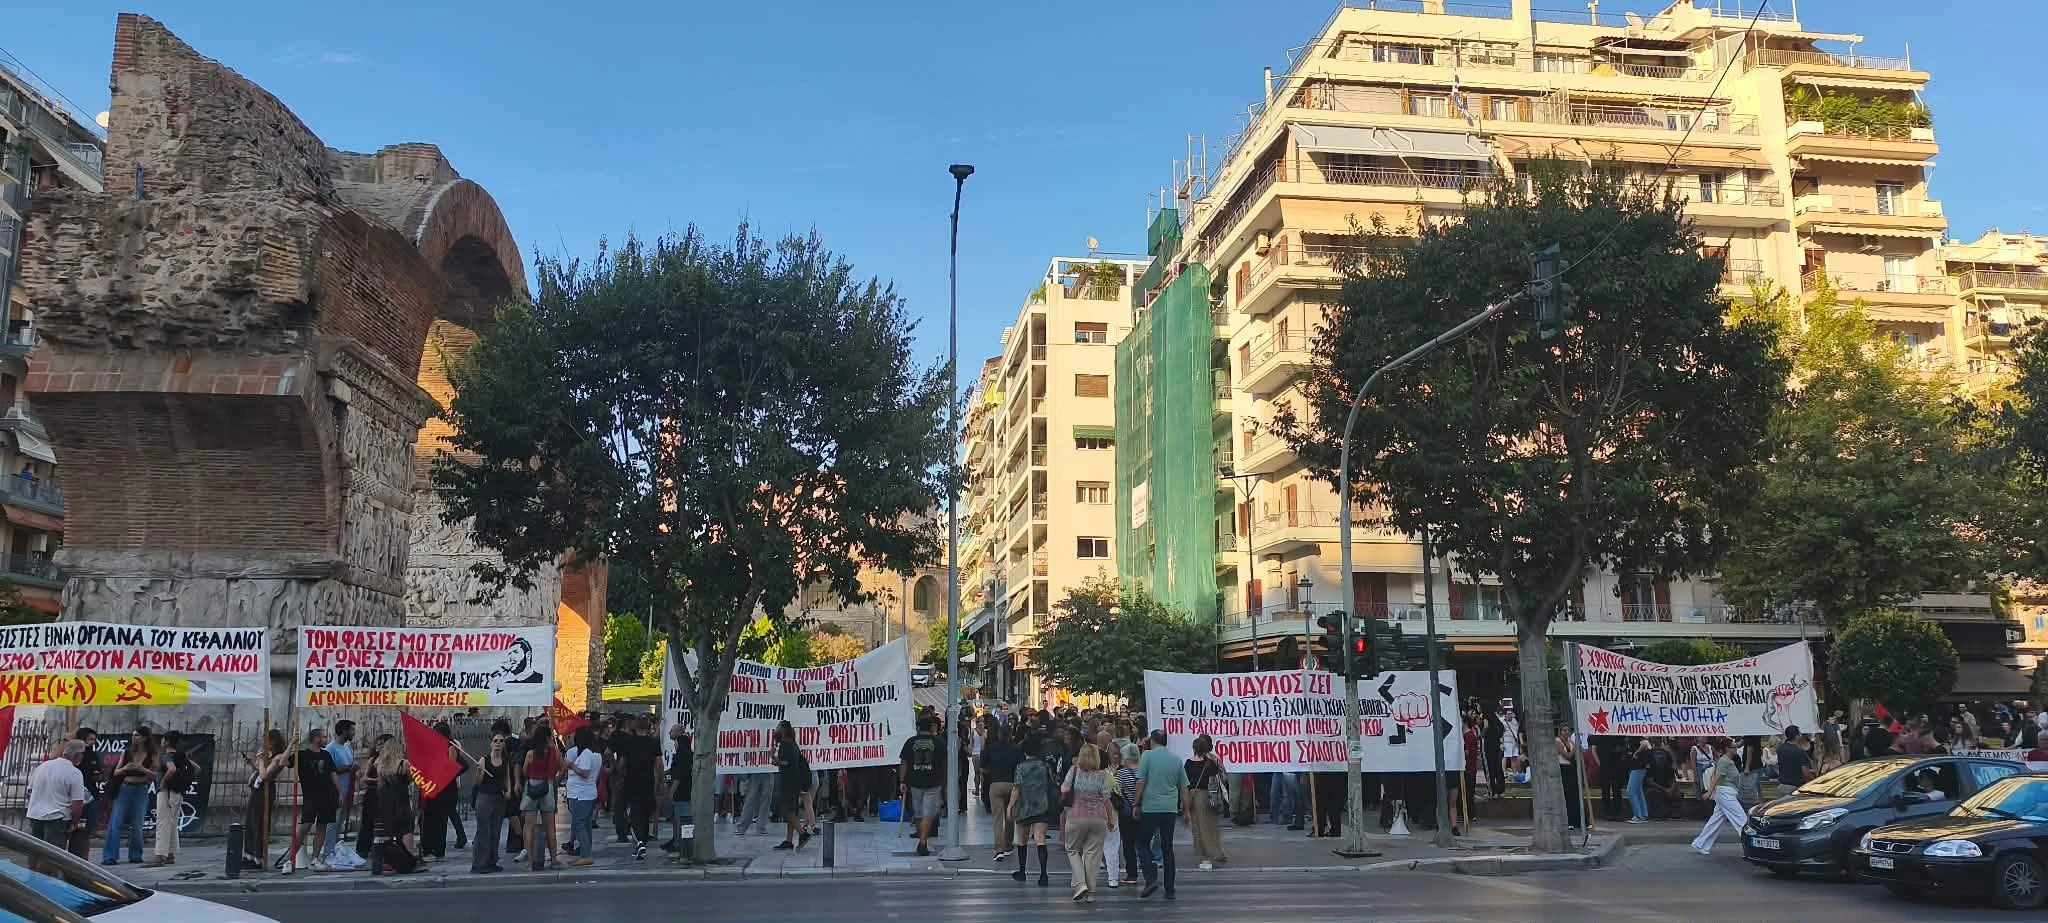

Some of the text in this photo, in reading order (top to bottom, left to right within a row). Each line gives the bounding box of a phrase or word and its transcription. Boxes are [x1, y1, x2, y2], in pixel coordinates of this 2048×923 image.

[45, 626, 75, 647] ΕΙΝΑΙ
[78, 626, 144, 646] ΟΡΓΑΝΑ
[151, 629, 177, 648] ΤΟΥ
[305, 630, 338, 649] ΤΟΝ
[430, 634, 516, 651] ΤΣΑΚΙΖΟΥΝ
[39, 650, 124, 670] ΤΣΑΚΙΖΟΥΝ
[128, 650, 196, 671] ΑΓΩΝΕΣ
[306, 649, 384, 668] ΑΓΩΝΕΣ
[305, 669, 333, 688] ΕΞΩ
[338, 669, 350, 687] ΟΙ
[354, 669, 410, 688] ΦΑΣΙΣΤΕΣ
[458, 672, 490, 689] ΣΧΟΛΕΣ
[1211, 674, 1331, 697] Ο ΠΑΥΛΟΣ ΖΕΙ
[1754, 673, 1772, 686] ΚΑΙ
[309, 691, 469, 705] ΑΓΩΝΙΣΤΙΚΕΣ ΚΙΝΗΣΕΙΣ
[1659, 706, 1728, 723] ΕΝΟΤΗΤΑ
[93, 739, 128, 752] ΥΛΟΣ
